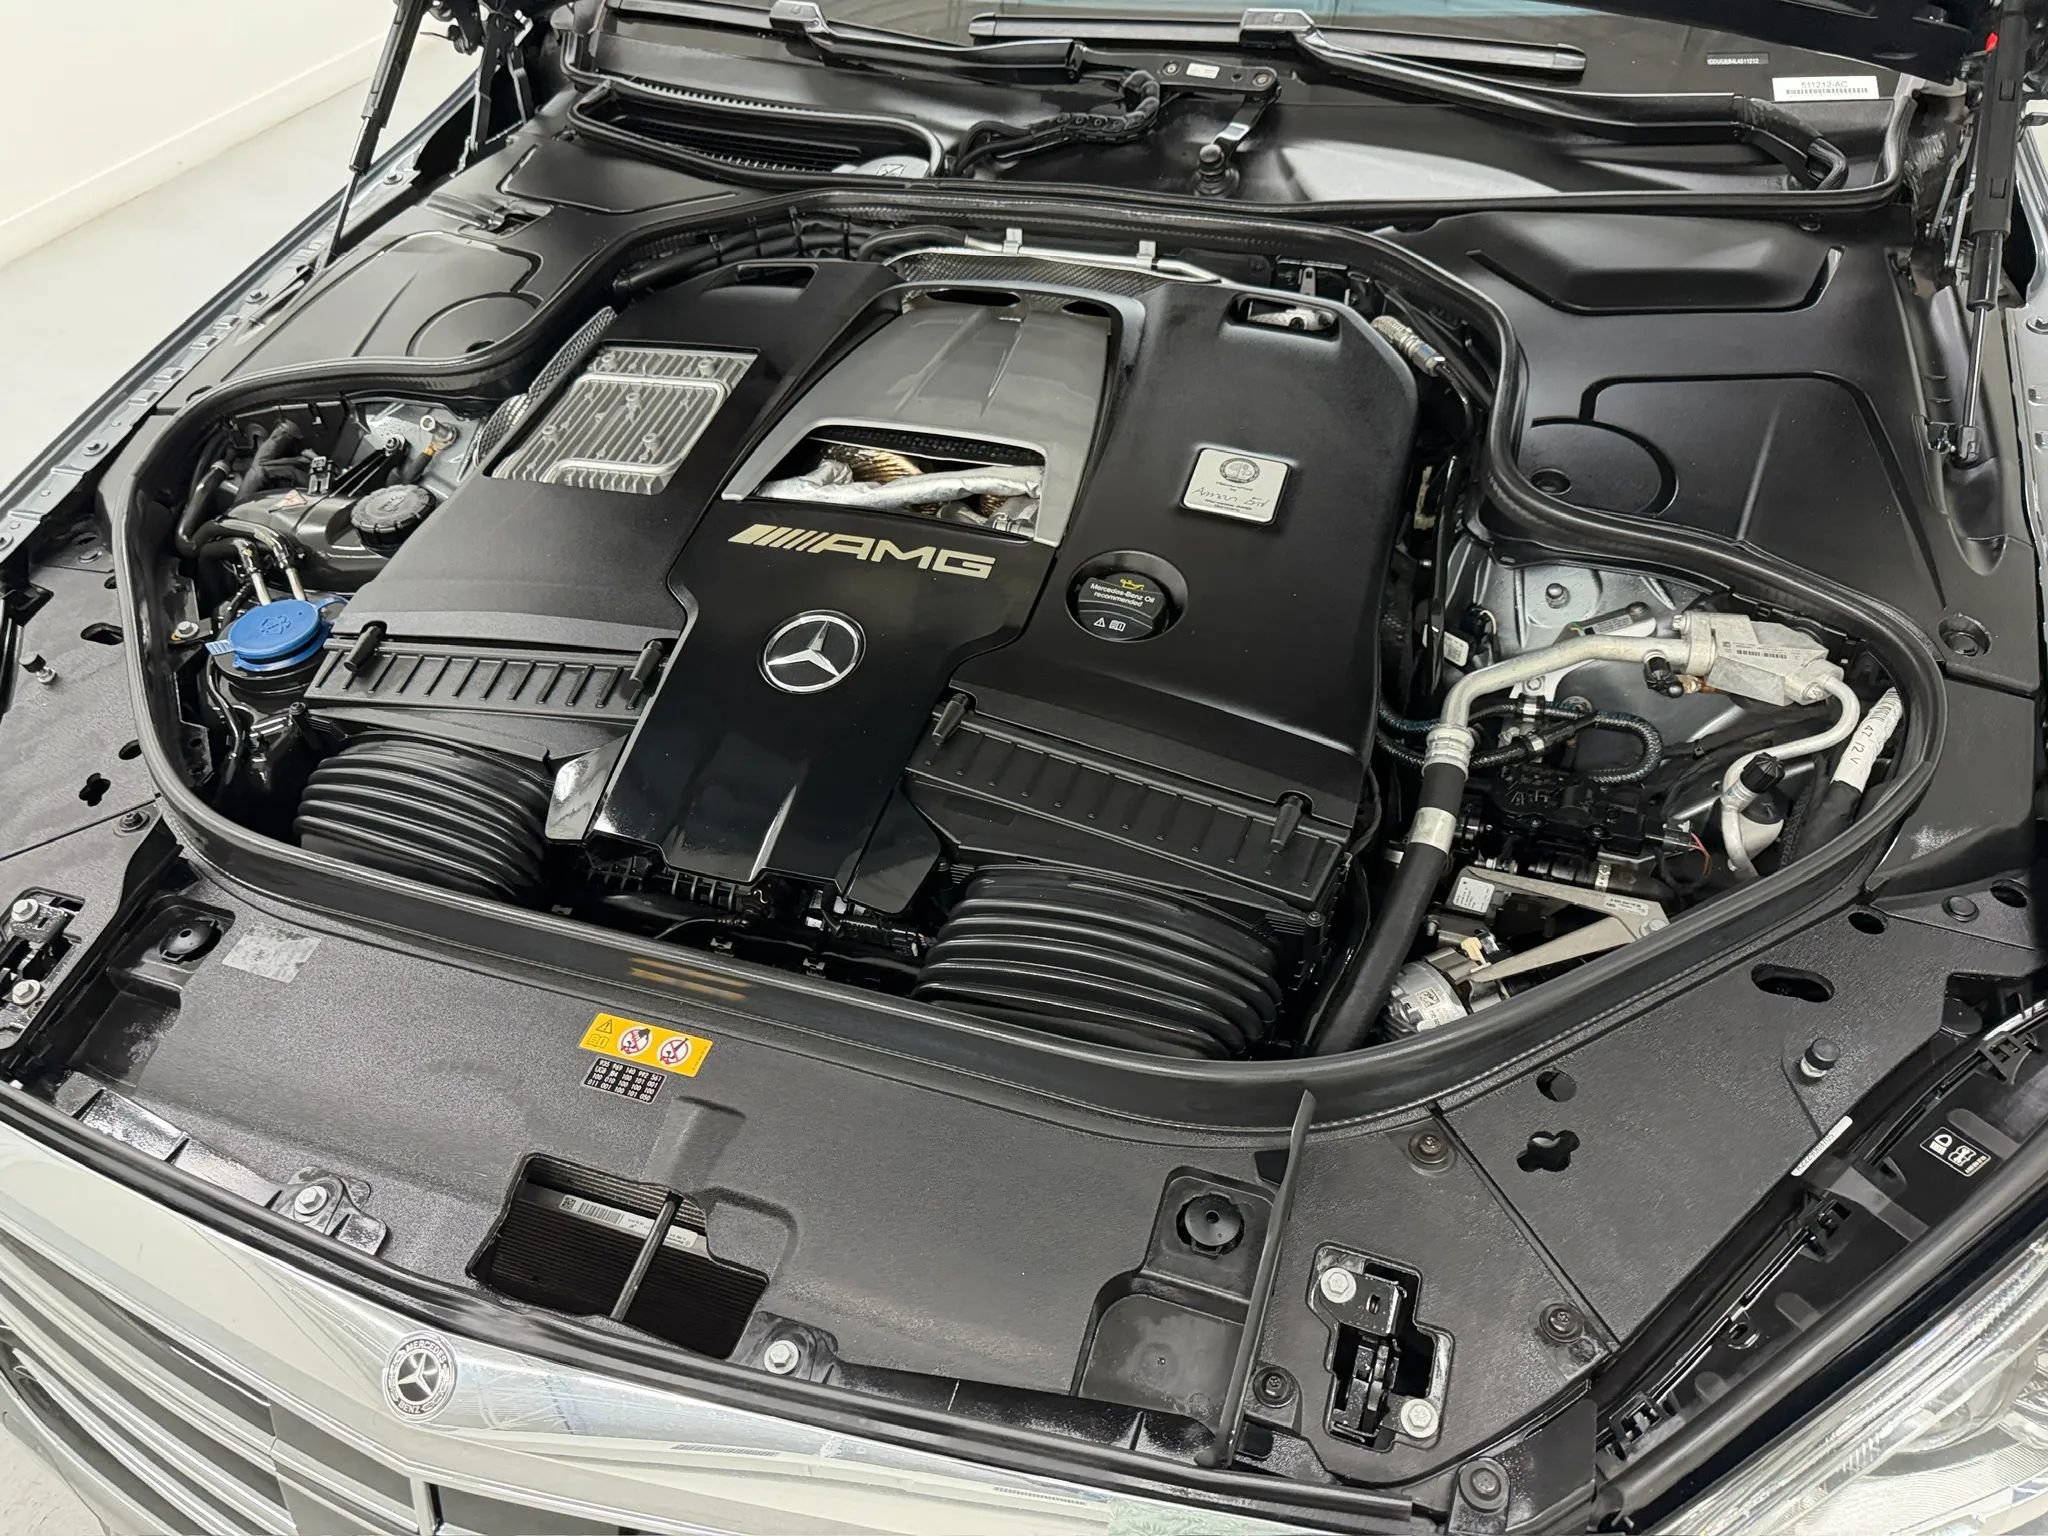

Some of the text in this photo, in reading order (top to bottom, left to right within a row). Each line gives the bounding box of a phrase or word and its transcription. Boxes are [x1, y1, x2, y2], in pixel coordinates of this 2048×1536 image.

[1801, 80, 1848, 89] 511212-AC
[807, 533, 996, 579] AMG
[1090, 583, 1155, 604] Mercedes-Benz Oil
[1094, 592, 1143, 607] recommended
[587, 1079, 598, 1087] 011
[614, 1086, 625, 1094] 100
[627, 1090, 638, 1098] 101
[592, 1073, 655, 1095] 100 010 100 100 100
[622, 1073, 633, 1081] 100
[635, 1077, 645, 1085] 101
[647, 1080, 659, 1088] 001
[405, 1340, 447, 1364] MERCEDES
[398, 1400, 421, 1413] BENZ
